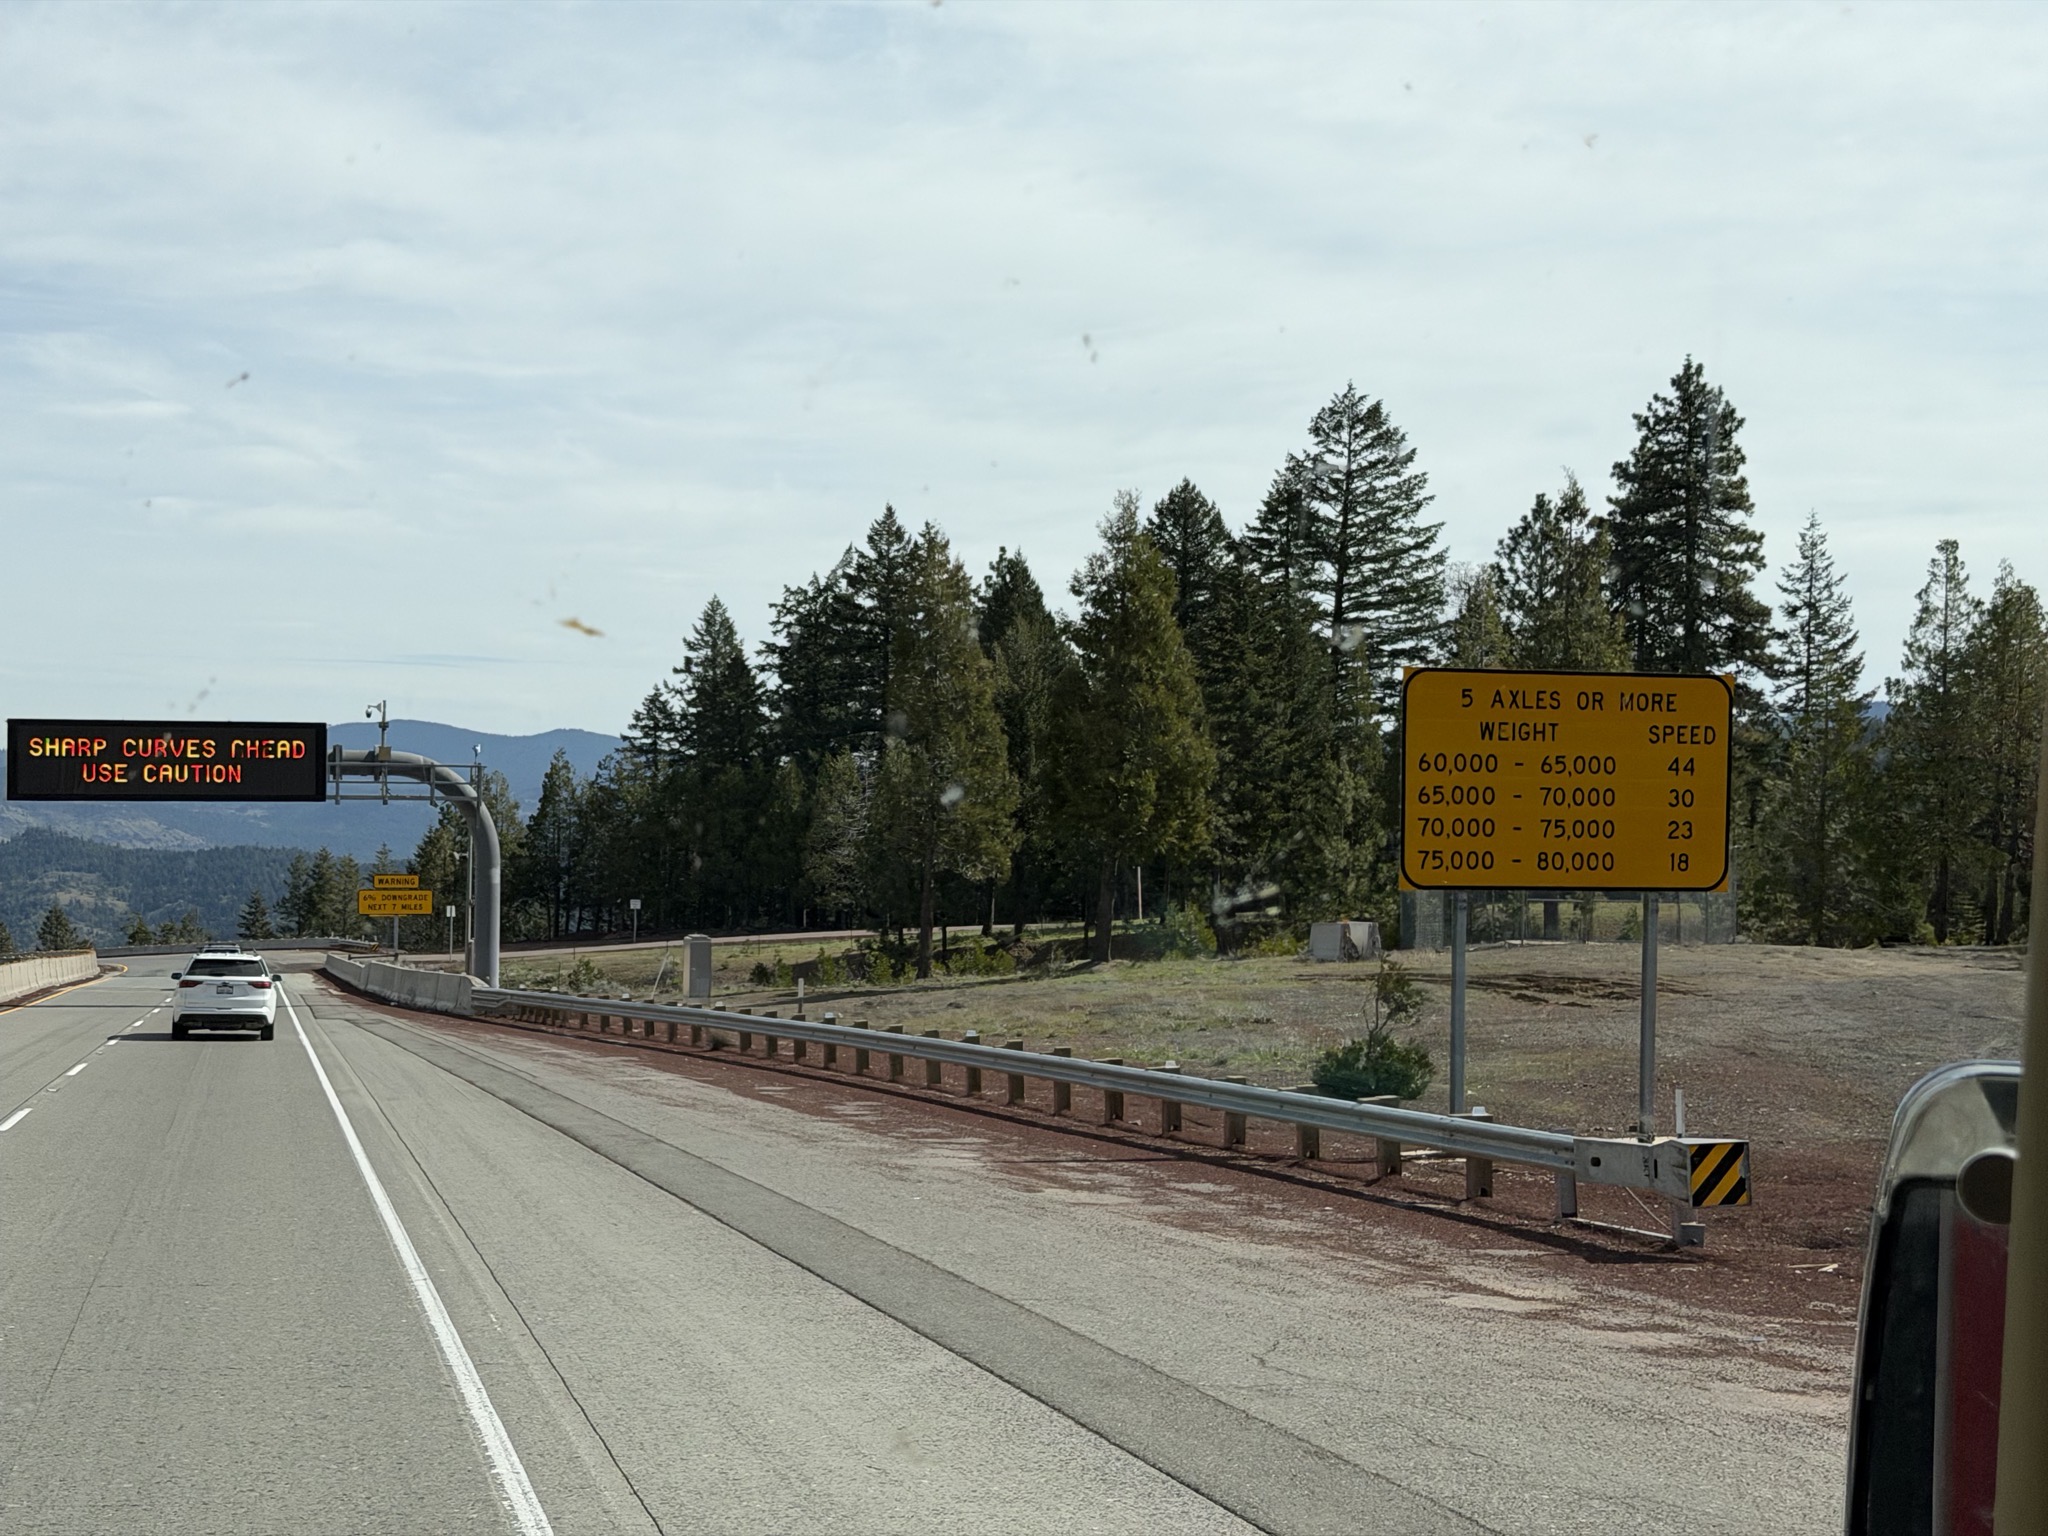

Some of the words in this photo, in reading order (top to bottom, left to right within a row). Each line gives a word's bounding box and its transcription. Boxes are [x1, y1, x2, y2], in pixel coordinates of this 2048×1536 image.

[1461, 689, 1473, 707] 5
[1491, 690, 1561, 709] AXLES
[1576, 692, 1604, 710] OR
[1620, 692, 1677, 712] MORE
[1479, 722, 1559, 742] WEIGHT
[1648, 725, 1716, 745] SPEED
[29, 737, 107, 757] SHARP
[122, 738, 216, 758] CURVES
[82, 763, 128, 783] USE
[143, 764, 242, 783] CAUTION
[1418, 753, 1498, 775] 60,000
[1540, 755, 1617, 776] 65,000
[1667, 757, 1695, 776] 44
[1417, 786, 1496, 807] 65,000
[1539, 787, 1616, 809] 70,000
[1668, 789, 1695, 808] 30
[1417, 818, 1496, 839] 70,000
[1540, 819, 1615, 841] 75,000
[1667, 821, 1693, 840] 23
[1417, 850, 1495, 871] 75,000
[1537, 852, 1614, 873] 80,000
[1669, 853, 1689, 872] 18
[378, 877, 416, 885] WARNING
